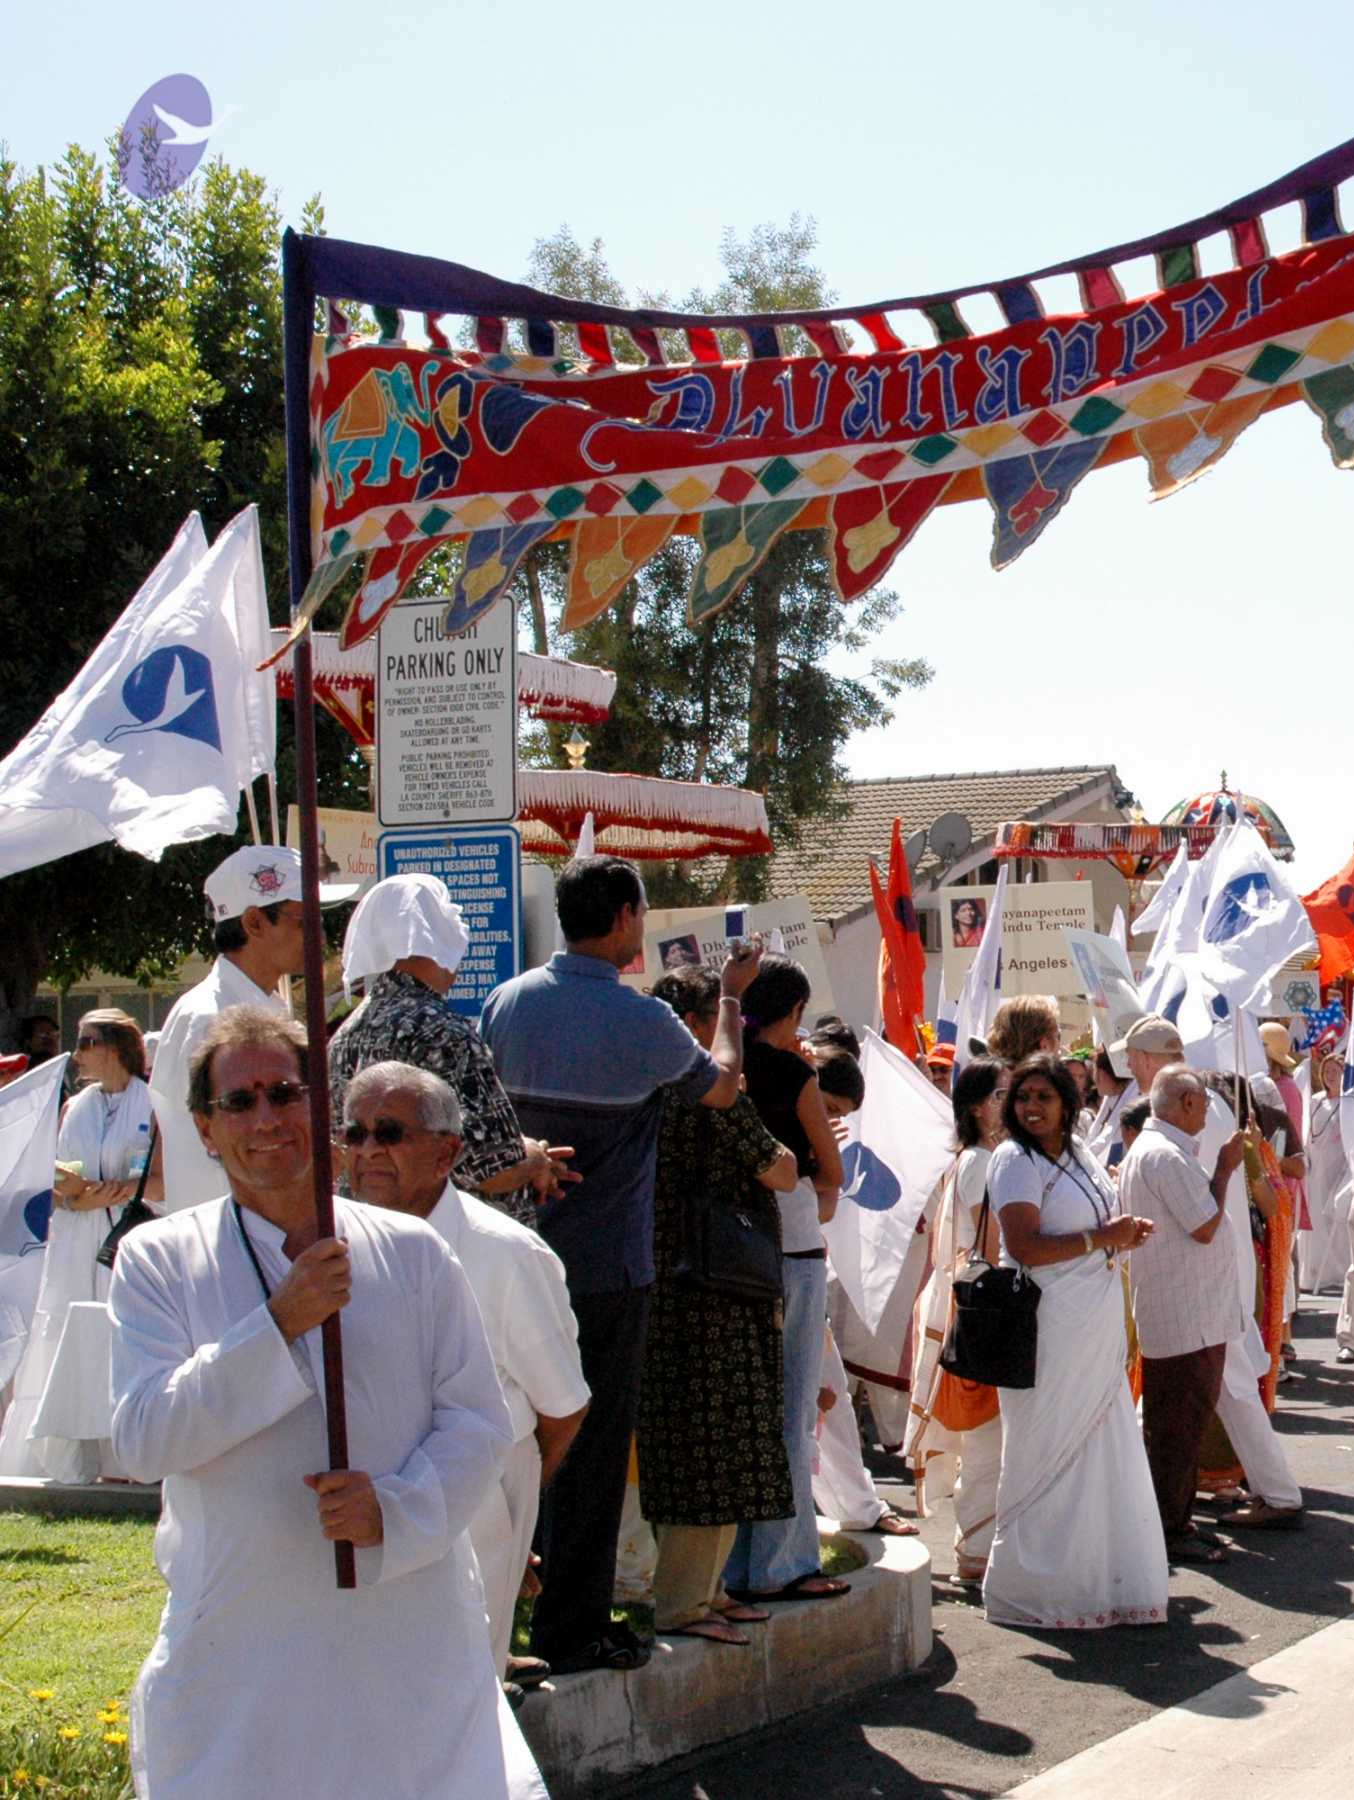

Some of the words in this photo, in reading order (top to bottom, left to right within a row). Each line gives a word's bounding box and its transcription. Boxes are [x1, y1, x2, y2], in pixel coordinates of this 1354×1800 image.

[387, 651, 456, 680] PARKING
[464, 647, 504, 676] ONLY
[418, 685, 426, 694] TO
[427, 684, 444, 693] PASS
[445, 683, 454, 692] OR
[455, 683, 468, 692] USE
[470, 682, 485, 691] ONLY
[424, 695, 437, 704] AND
[439, 693, 465, 703] SUBJECT
[468, 692, 476, 701] TO
[422, 704, 448, 714] SECTION
[414, 718, 423, 727] NO
[400, 727, 450, 738] SKATEBOARDING
[451, 726, 460, 735] OR
[471, 724, 492, 733] KARTS
[410, 737, 439, 747] ALLOWED
[441, 736, 449, 745] AT
[450, 736, 463, 744] ANY
[401, 753, 424, 762] PUBLIC
[426, 751, 452, 761] PARKING
[399, 762, 427, 772] VEHICLES
[429, 761, 443, 771] WILL
[445, 760, 453, 770] BE
[455, 759, 485, 769] REMOVED
[486, 758, 494, 768] AT
[404, 772, 429, 782] VEHICLE
[459, 769, 487, 779] EXPENSE
[404, 782, 417, 791] FOR
[419, 781, 439, 791] TOWED
[441, 780, 471, 790] VEHICLES
[472, 779, 487, 788] CALL
[400, 792, 409, 802] LA
[410, 791, 435, 801] COUNTY
[438, 790, 463, 799] SHERIFF
[398, 802, 423, 812] SECTION
[451, 799, 476, 809] VEHICLE
[393, 846, 457, 860] UNAUTHORIZED
[458, 843, 500, 857] VEHICLES
[397, 861, 431, 873] PARKED
[432, 860, 442, 872] IN
[443, 858, 496, 872] DESIGNATED
[446, 873, 480, 886] SPACES
[481, 872, 499, 885] NOT
[471, 916, 489, 928] FOR
[1003, 921, 1033, 932] indu
[471, 945, 497, 957] AWAY
[1008, 957, 1068, 973] Angeles
